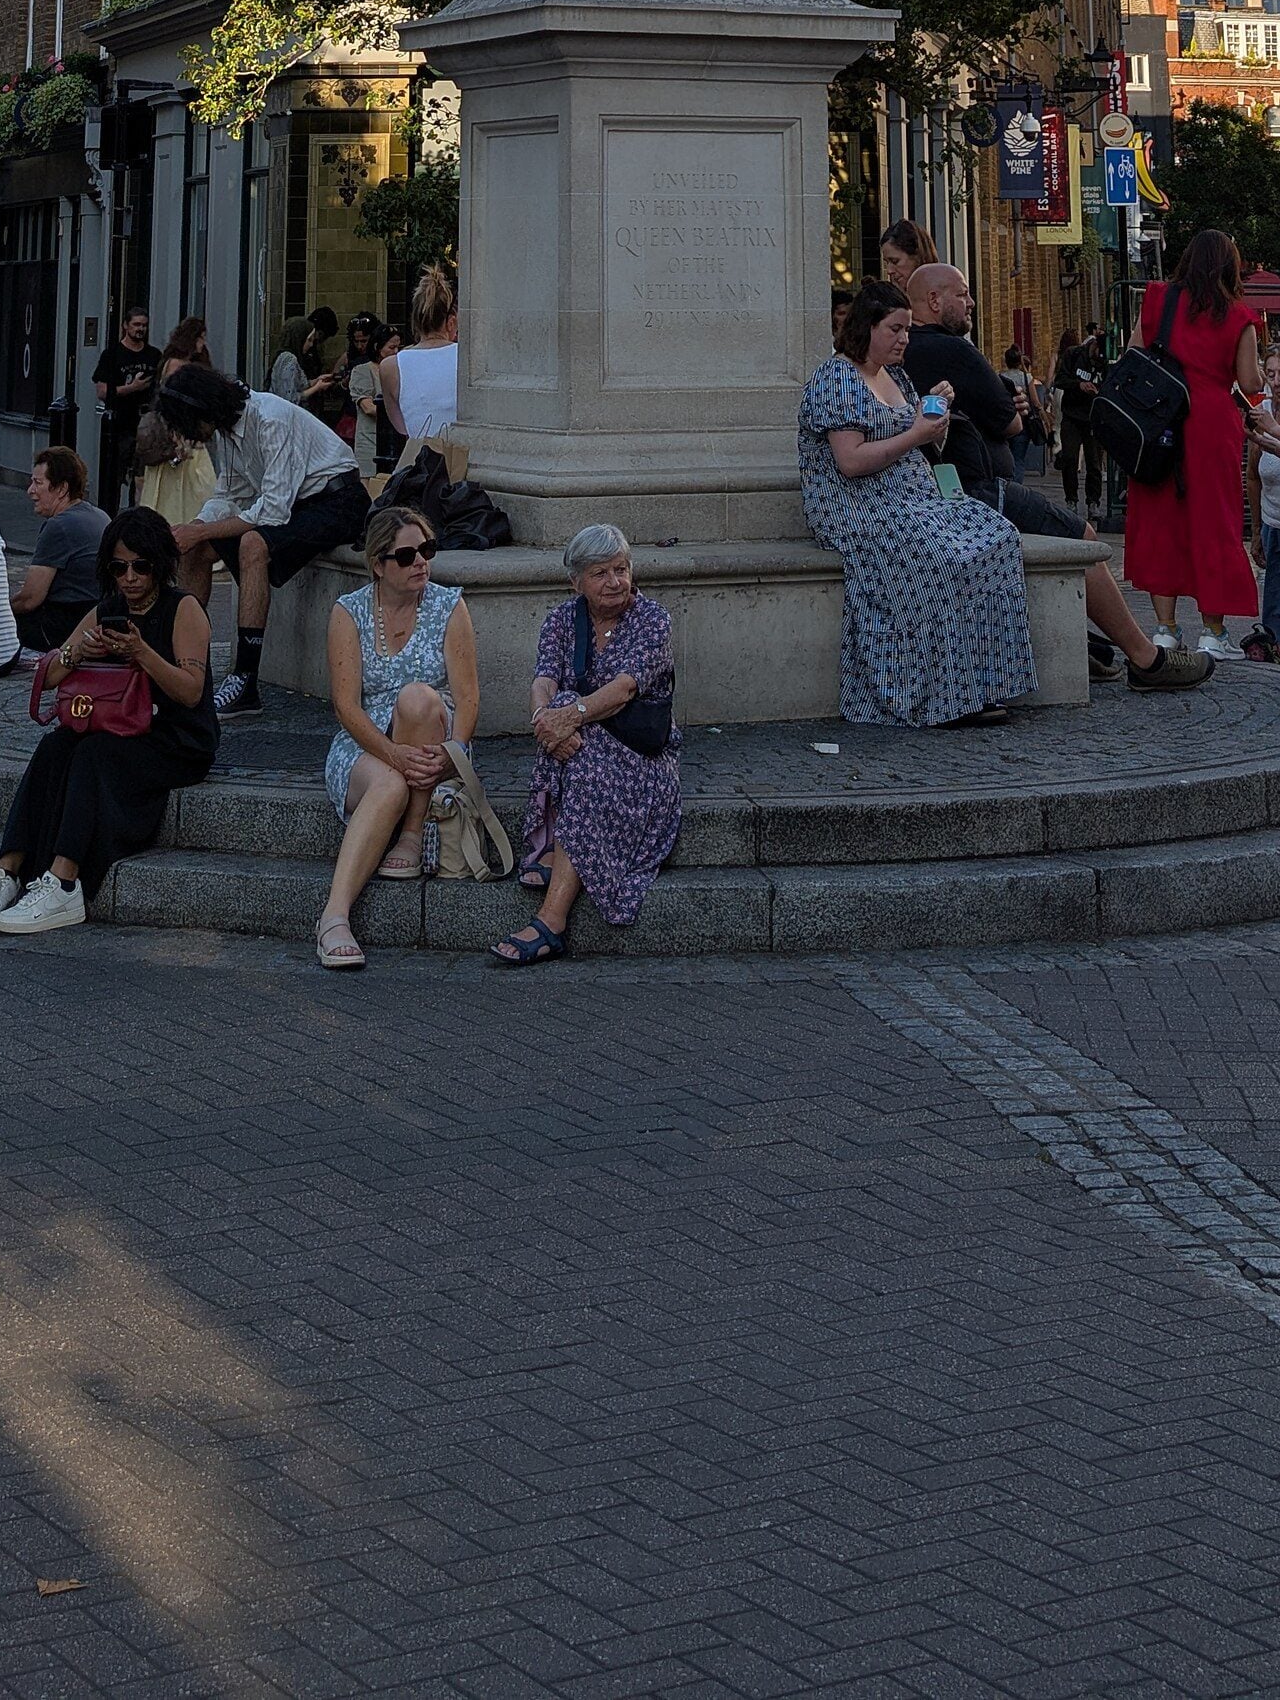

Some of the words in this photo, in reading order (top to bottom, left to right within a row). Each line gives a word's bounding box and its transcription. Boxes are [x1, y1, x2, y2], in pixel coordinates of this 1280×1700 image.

[1006, 159, 1036, 167] WHITE
[1010, 167, 1032, 175] PINE
[653, 173, 739, 189] UNVEILED
[629, 200, 649, 216] BY
[653, 200, 687, 216] HER
[615, 226, 687, 258] QUEEN
[692, 227, 777, 248] BEATRIX
[668, 257, 691, 274] OF
[692, 257, 727, 274] THE
[632, 283, 762, 301] NETHERLANDS
[644, 310, 664, 328] 29
